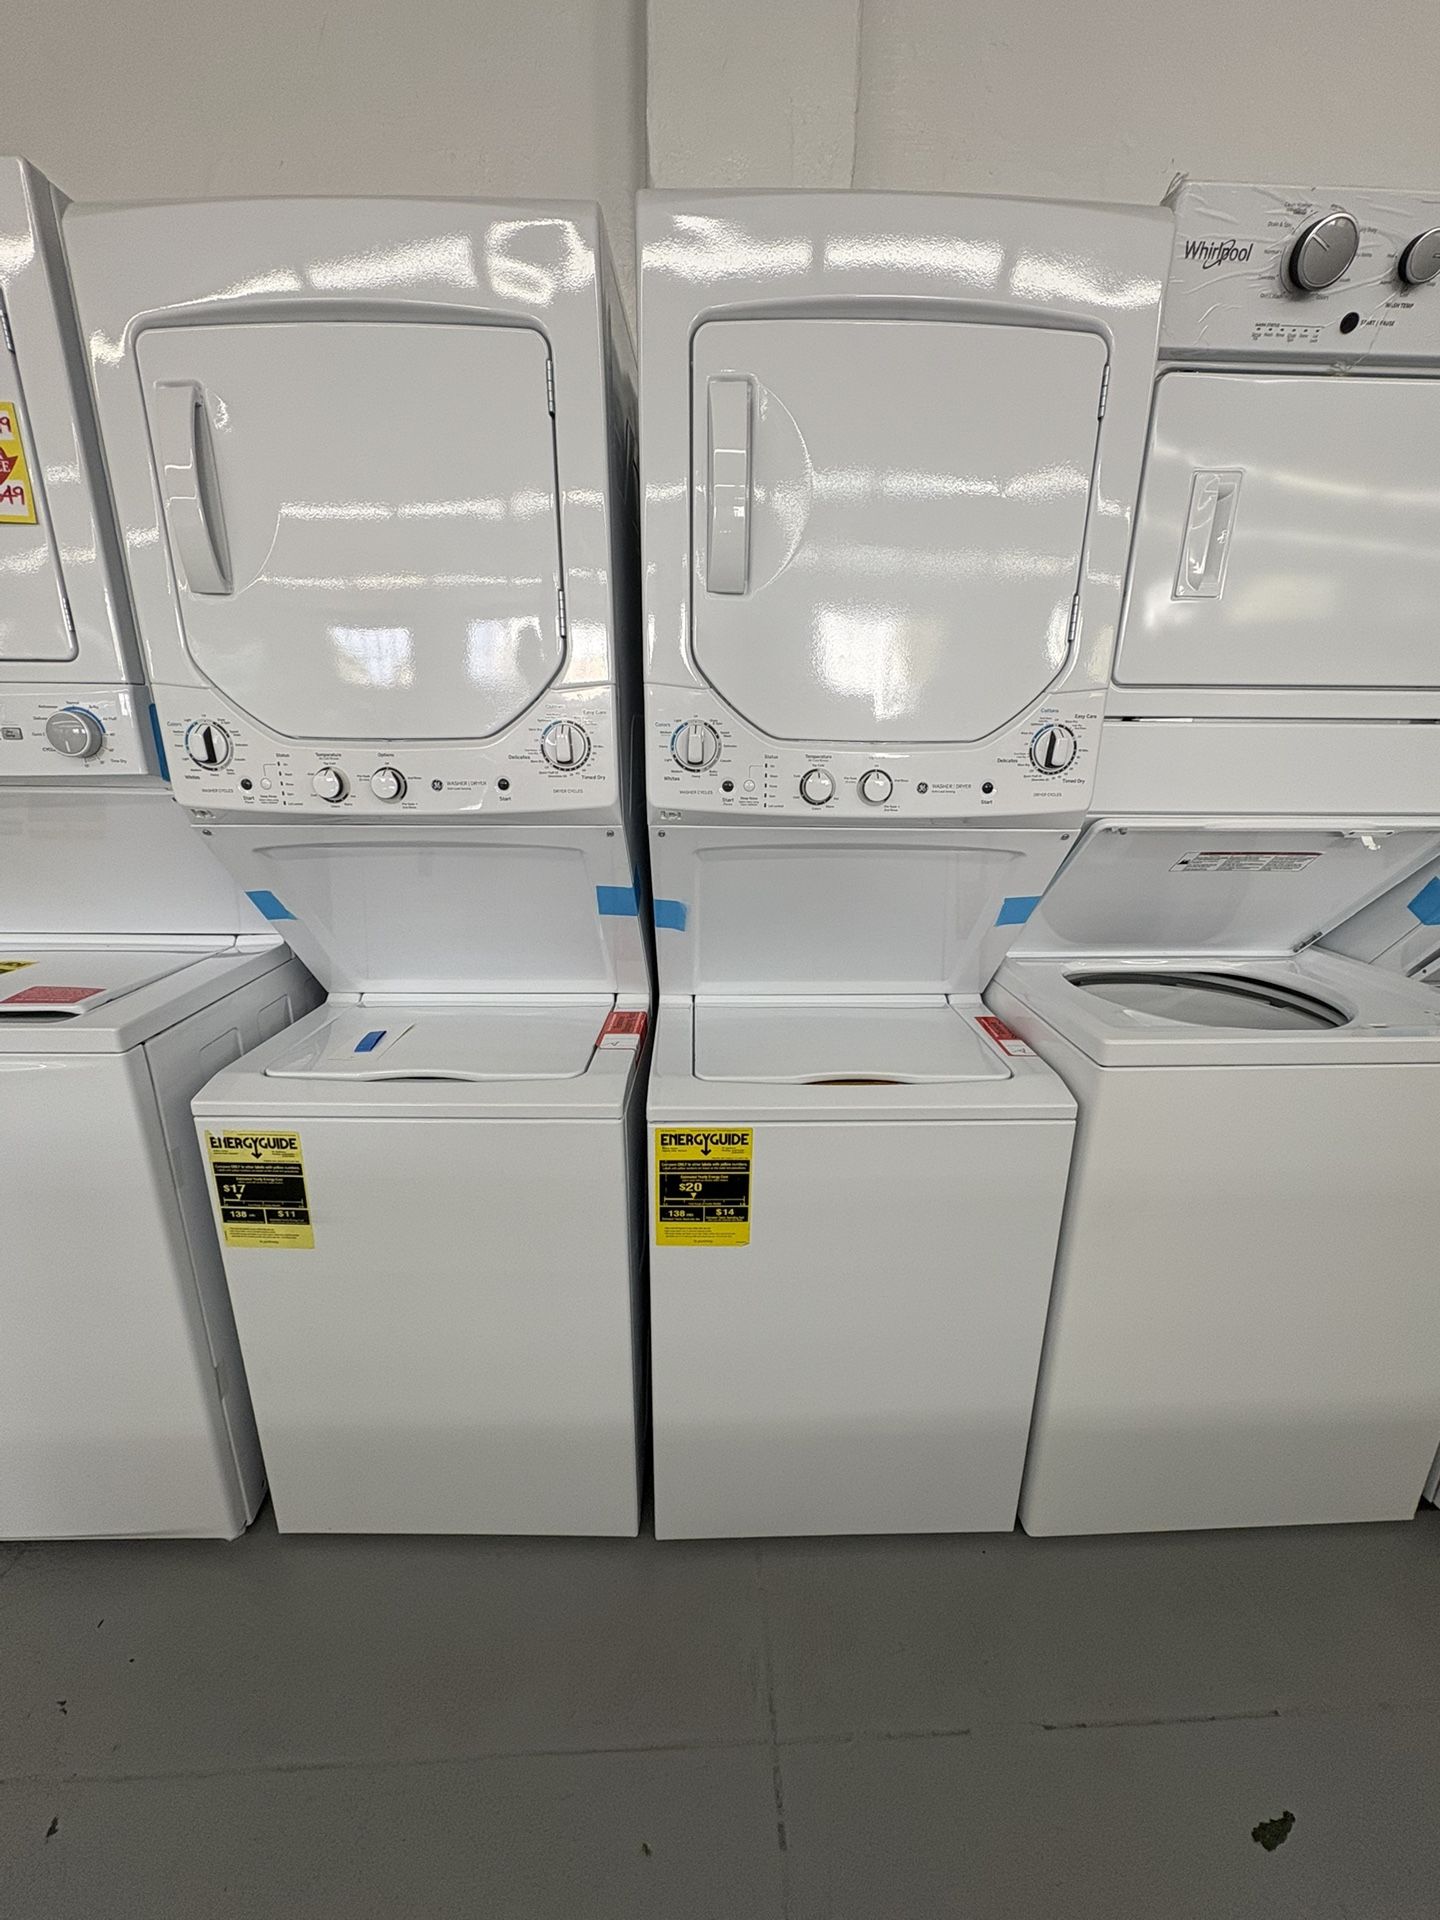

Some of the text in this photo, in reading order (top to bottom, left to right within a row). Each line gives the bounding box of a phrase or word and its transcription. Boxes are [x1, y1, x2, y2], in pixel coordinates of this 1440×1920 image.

[1185, 239, 1254, 270] Whirlpool
[660, 1133, 749, 1145] ENERGYGUIDE
[223, 1183, 246, 1193] $17
[679, 1182, 702, 1192] $20
[668, 1209, 685, 1217] 138
[716, 1208, 734, 1216] $14
